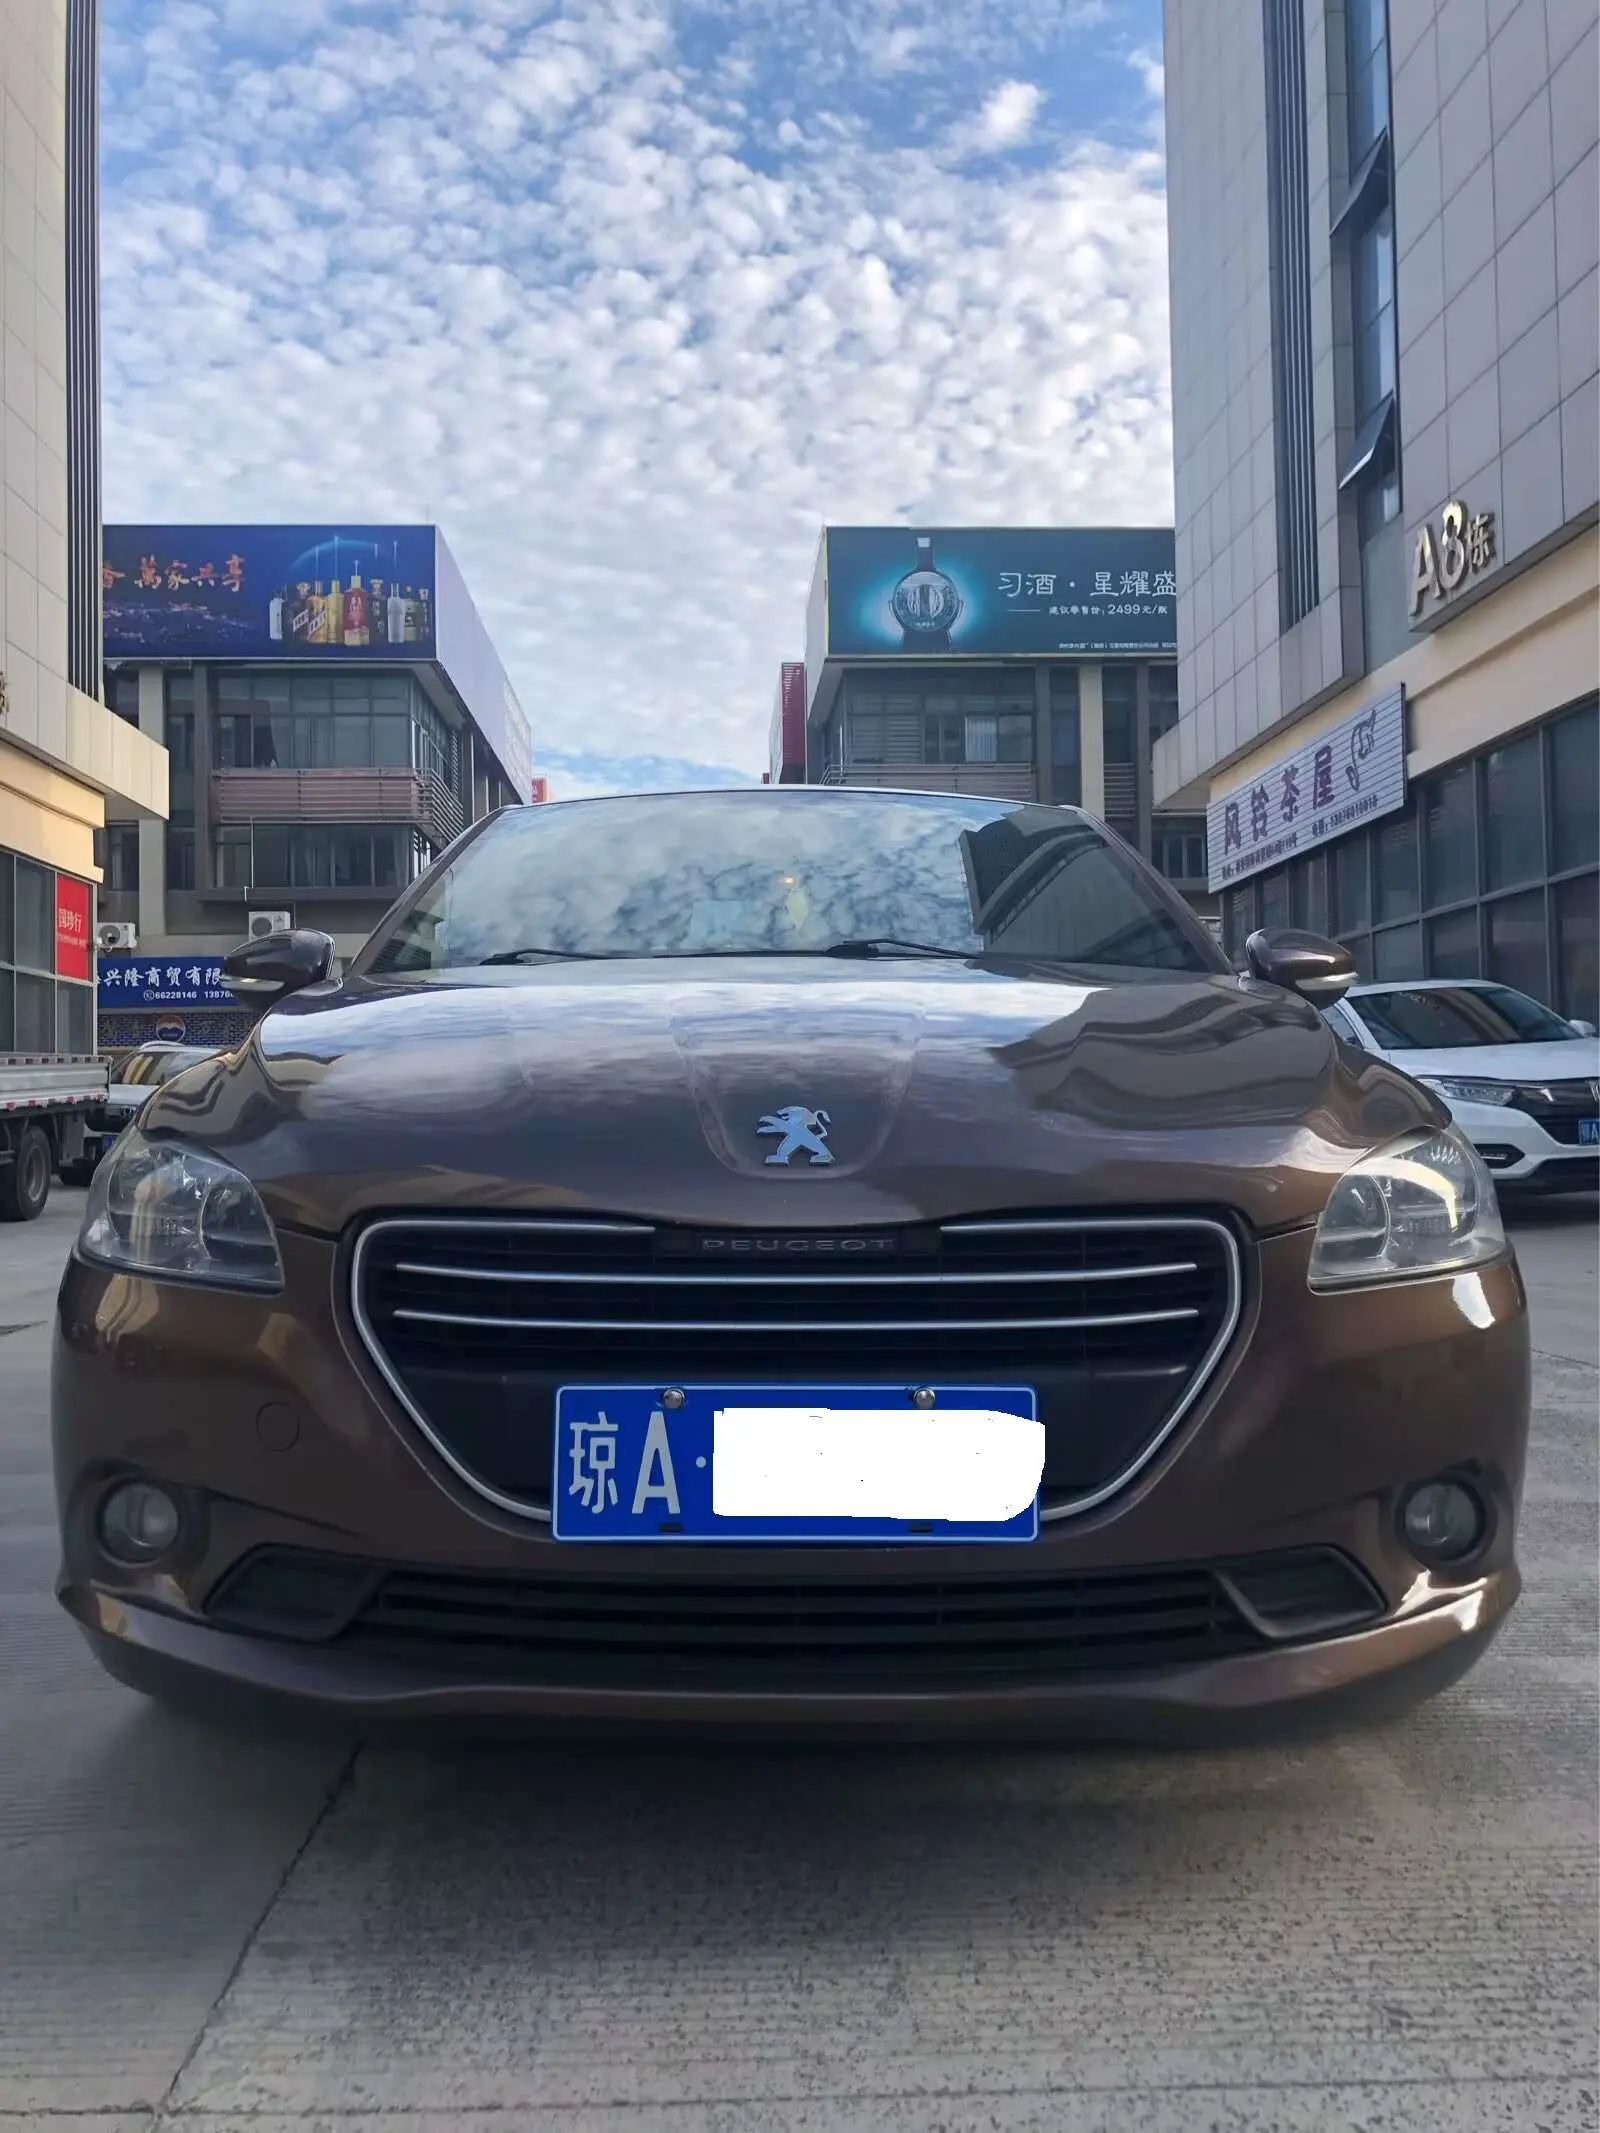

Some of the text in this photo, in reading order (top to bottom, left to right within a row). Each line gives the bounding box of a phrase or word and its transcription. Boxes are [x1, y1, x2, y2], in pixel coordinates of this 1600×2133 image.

[1224, 745, 1336, 856] 风铃茶屋
[155, 991, 197, 1000] 66228146
[702, 1238, 894, 1252] PEUGEOT
